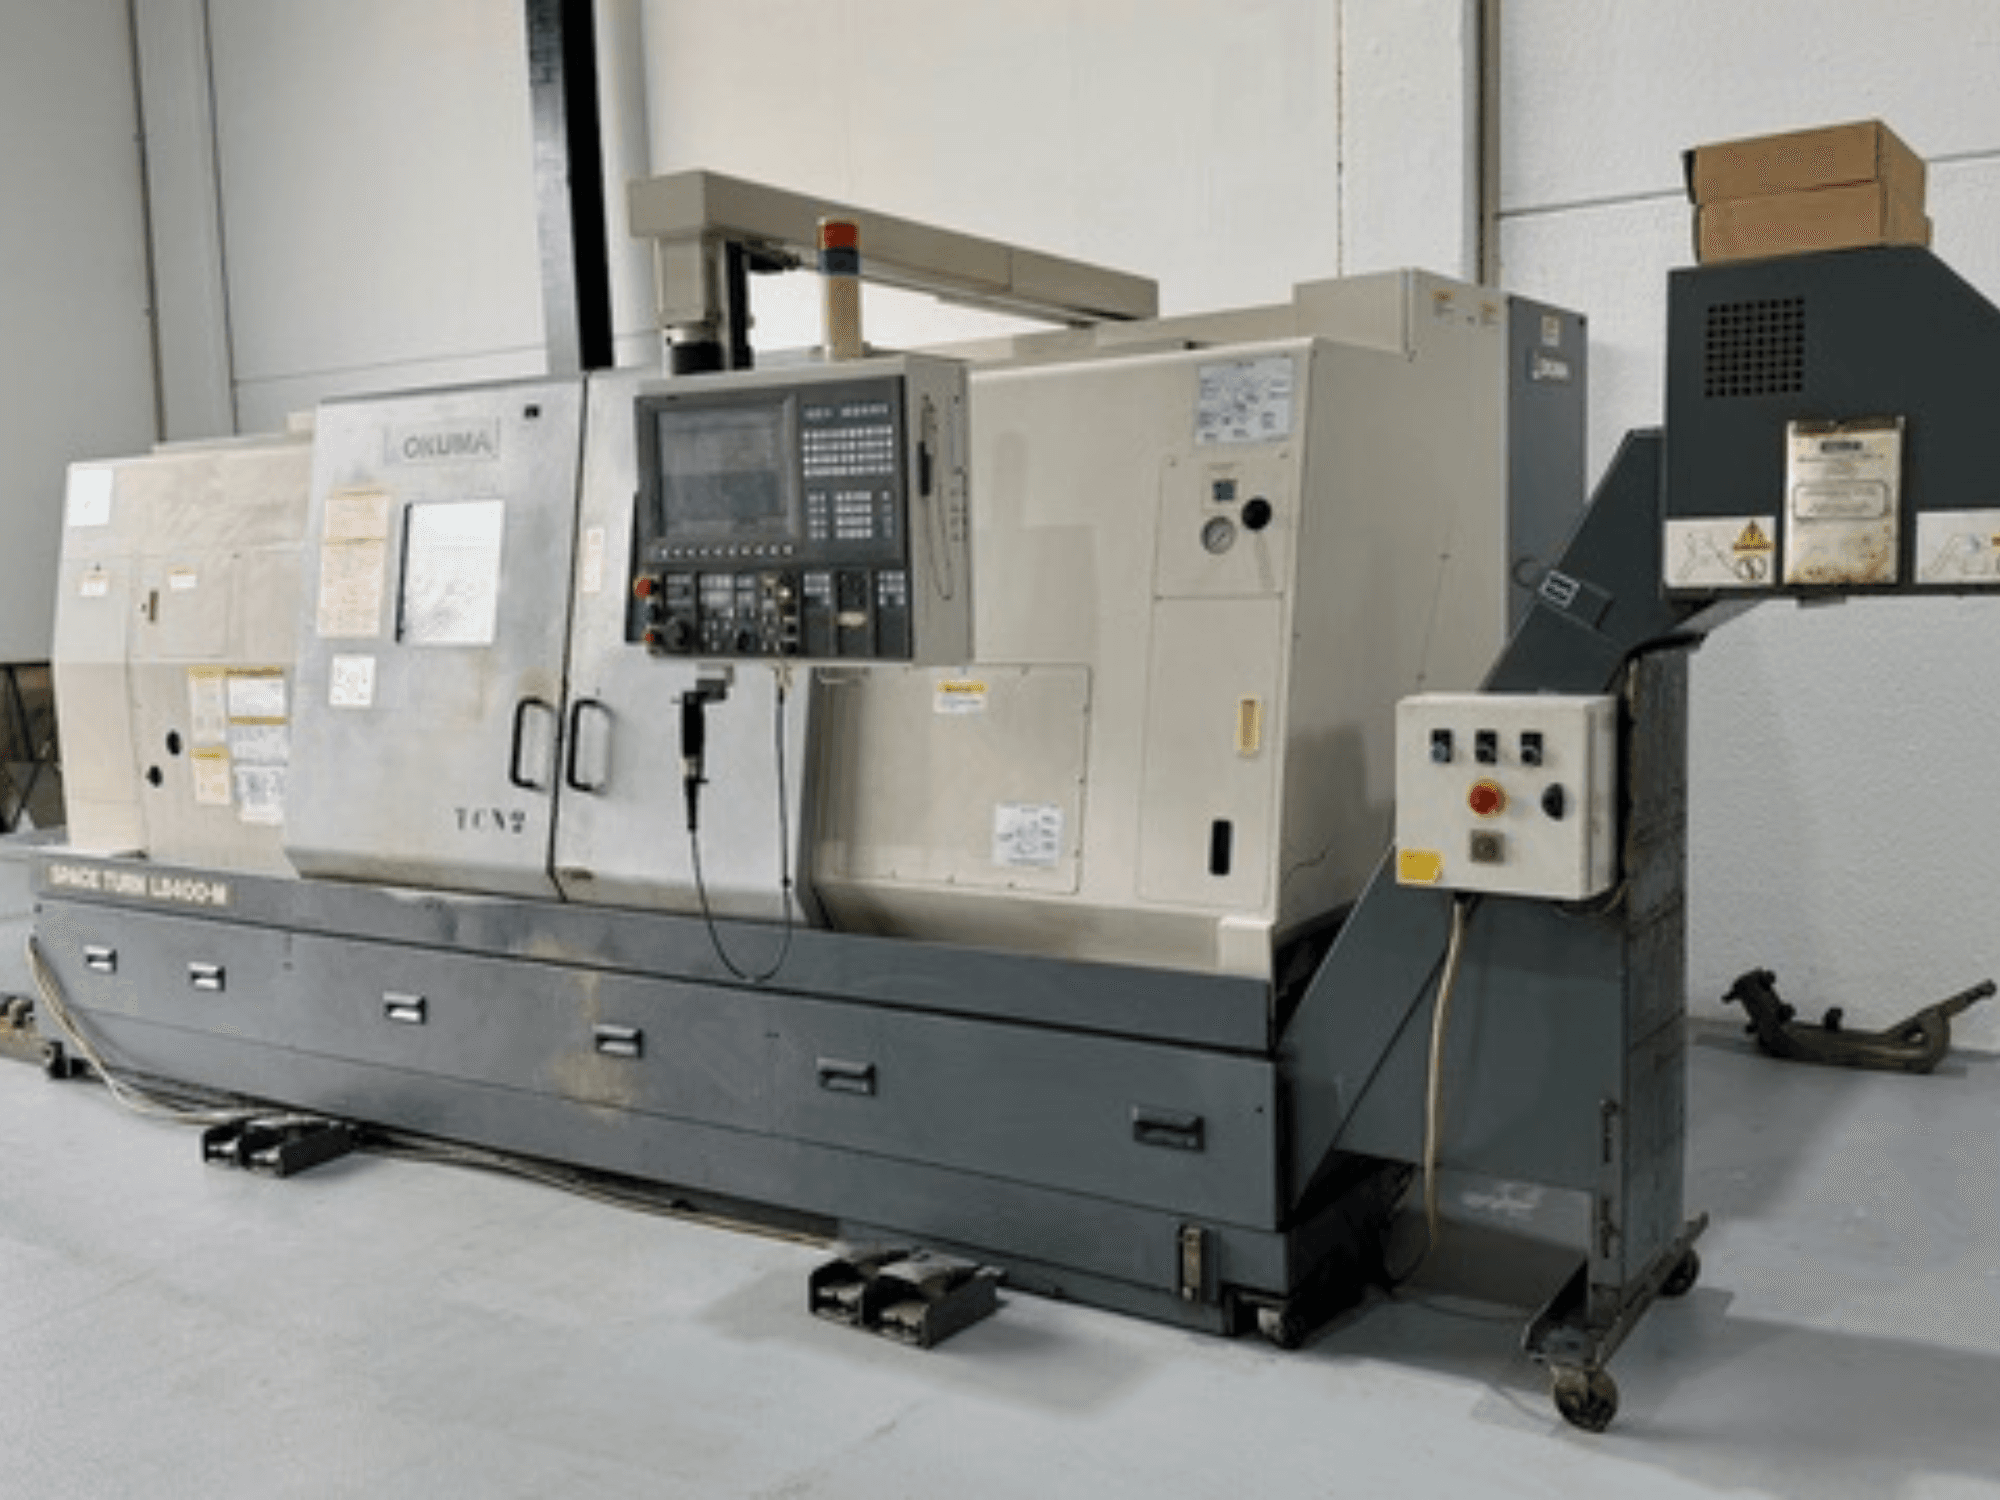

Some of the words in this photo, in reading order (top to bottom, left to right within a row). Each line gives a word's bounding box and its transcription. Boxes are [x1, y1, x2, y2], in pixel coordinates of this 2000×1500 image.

[402, 431, 494, 459] OKUMA
[50, 863, 99, 889] SPACE
[103, 869, 147, 897] TURN
